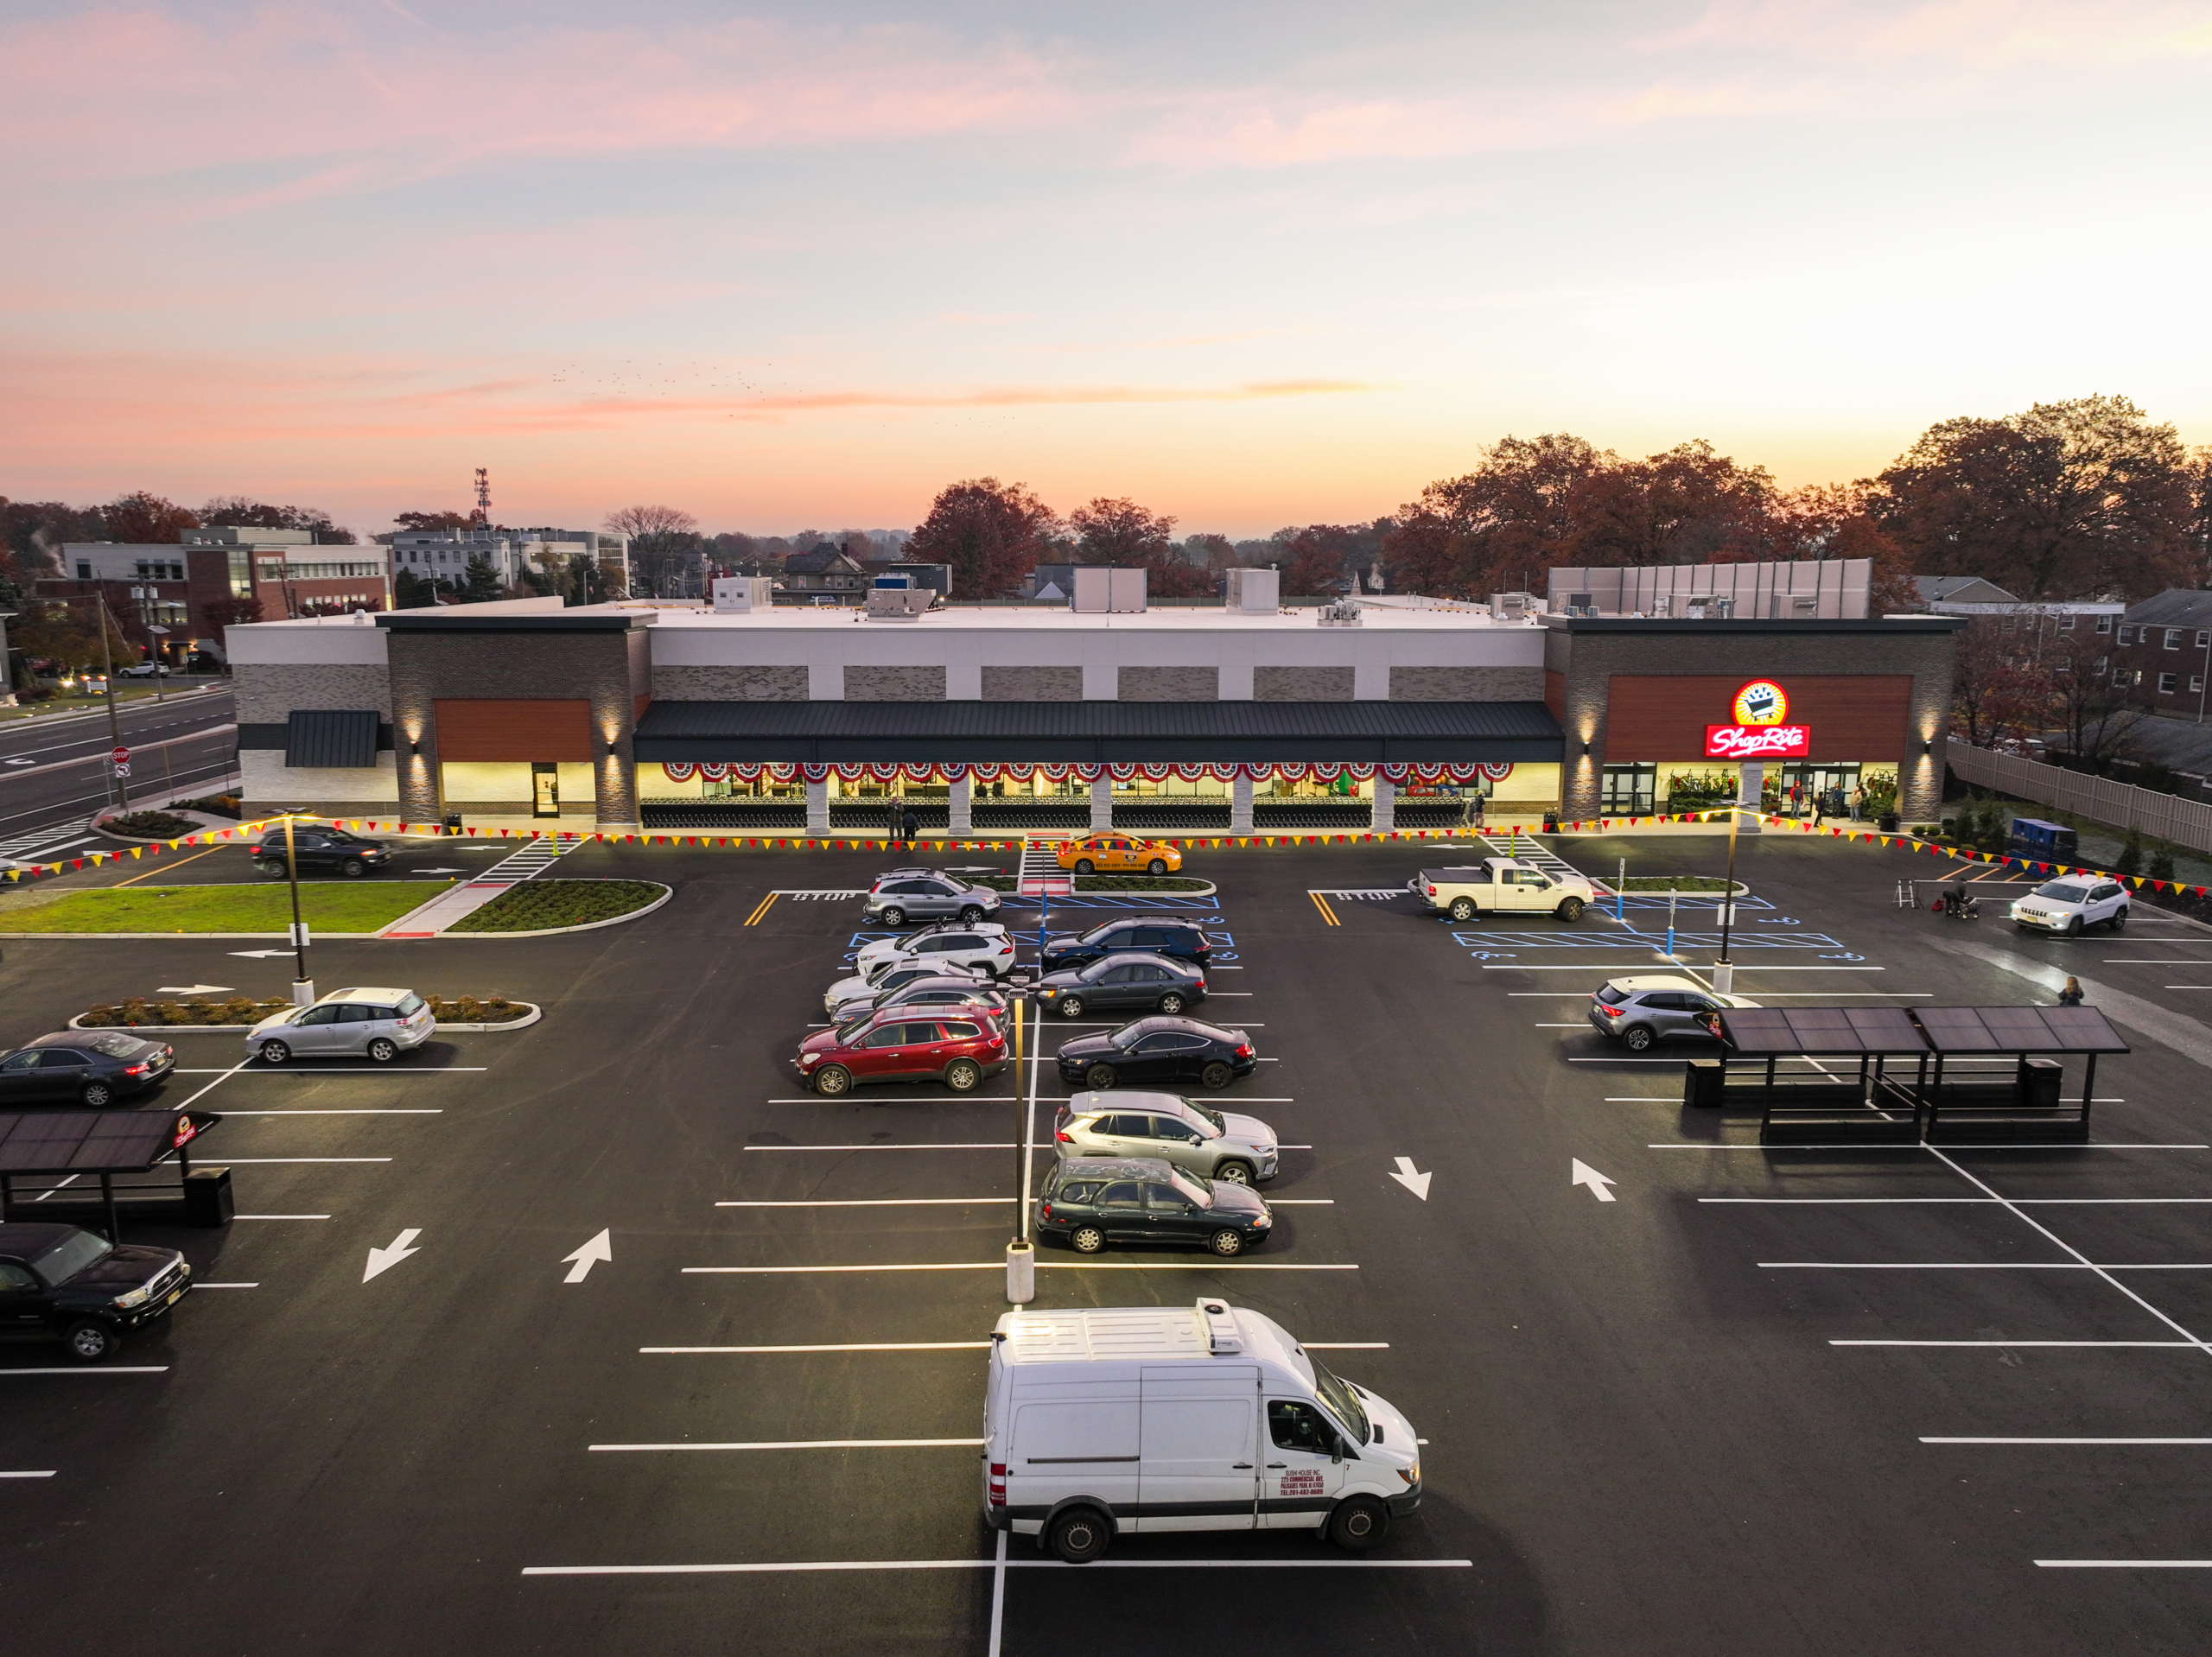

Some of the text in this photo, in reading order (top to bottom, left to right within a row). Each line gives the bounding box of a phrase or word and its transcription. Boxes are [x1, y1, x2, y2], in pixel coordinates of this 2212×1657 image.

[1710, 727, 1803, 756] ShopRite
[113, 751, 130, 759] STOP
[792, 892, 856, 901] STOP
[1336, 892, 1397, 900] STOP
